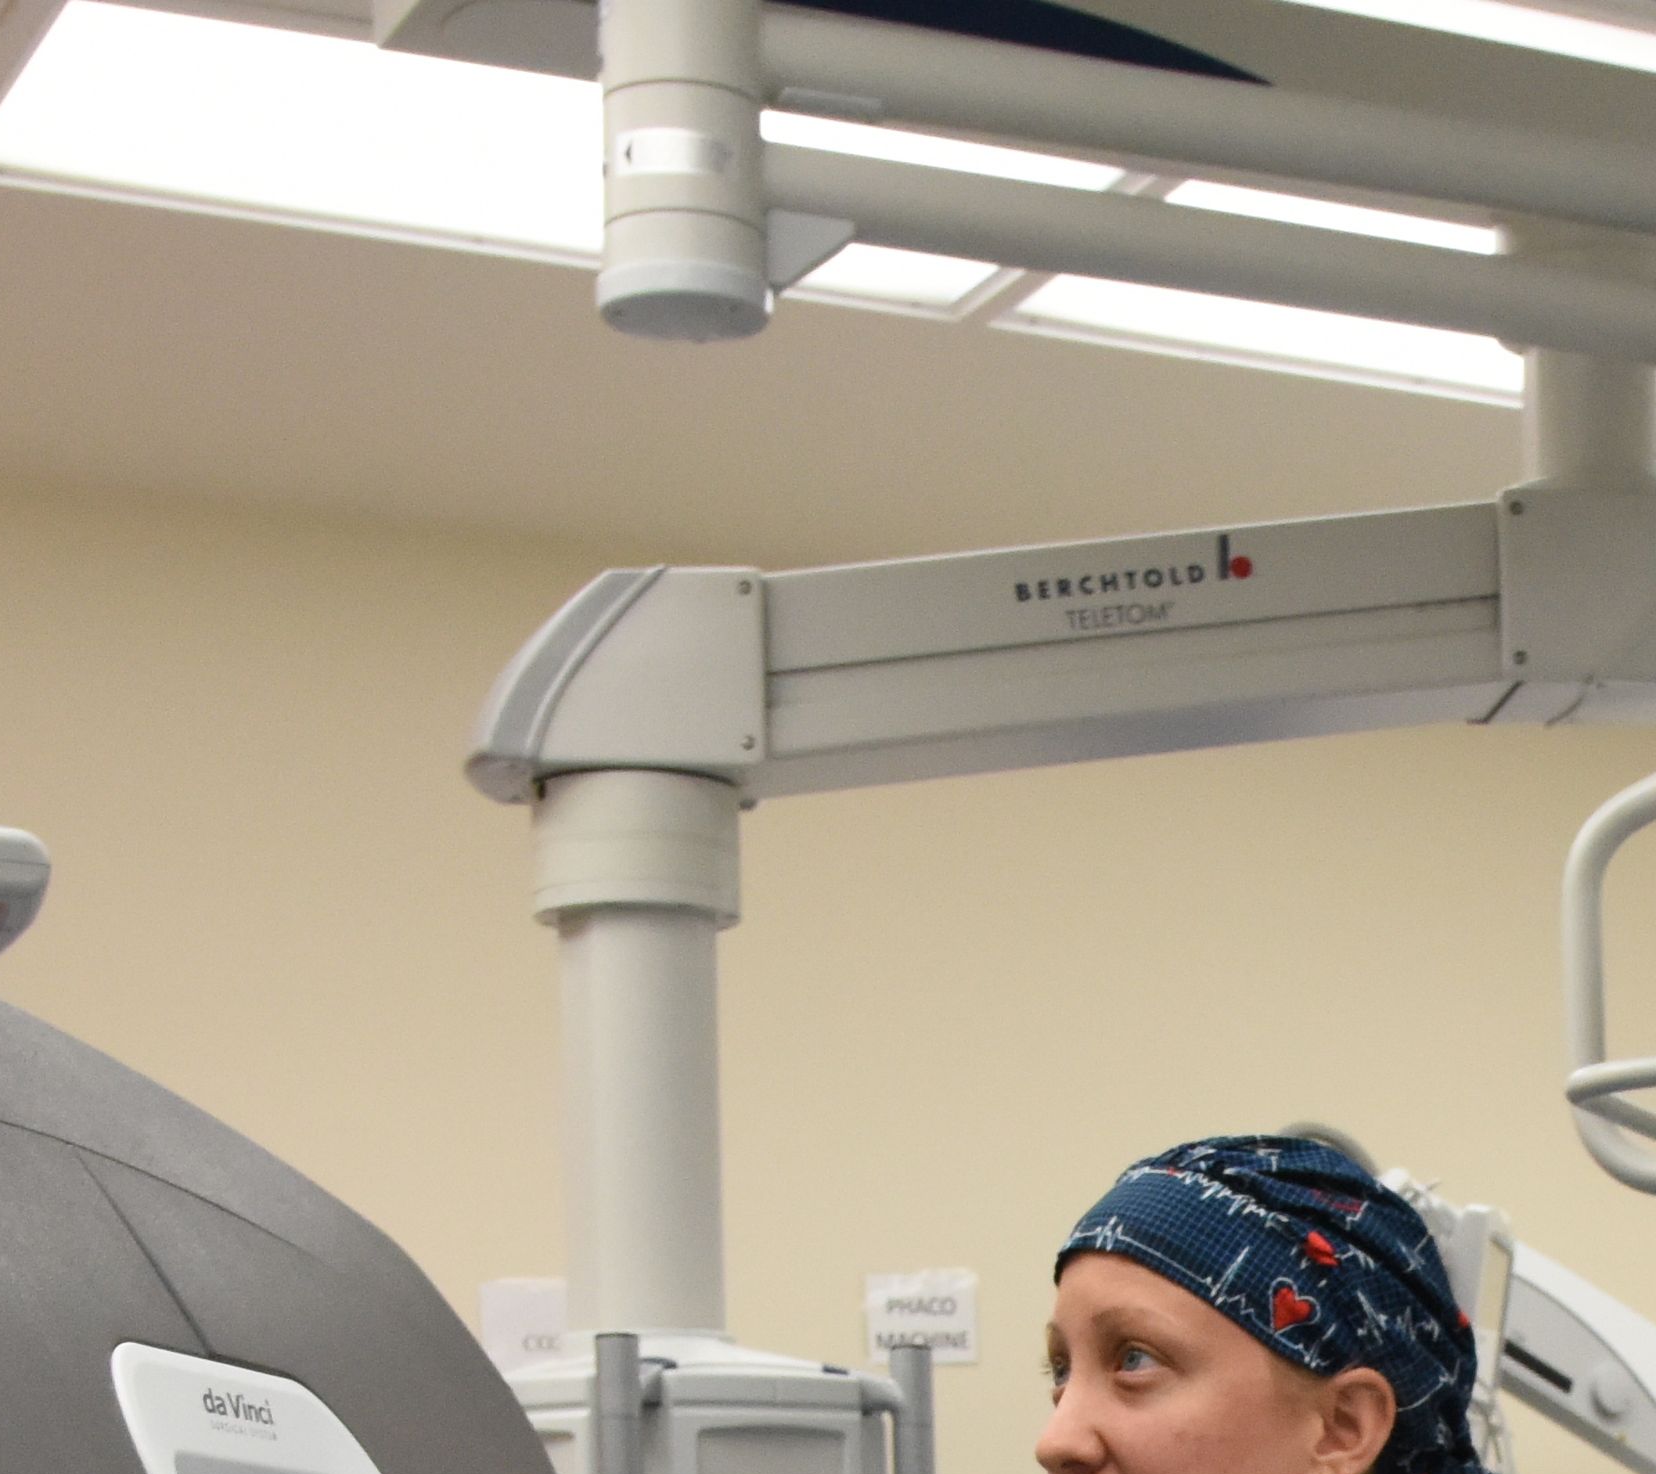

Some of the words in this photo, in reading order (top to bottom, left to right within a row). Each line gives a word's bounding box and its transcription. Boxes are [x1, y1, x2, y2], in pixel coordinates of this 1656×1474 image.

[1015, 565, 1206, 603] BERCHTOLD
[886, 1296, 958, 1316] PHACO
[202, 1387, 228, 1416] da
[226, 1391, 275, 1426] Vinci
